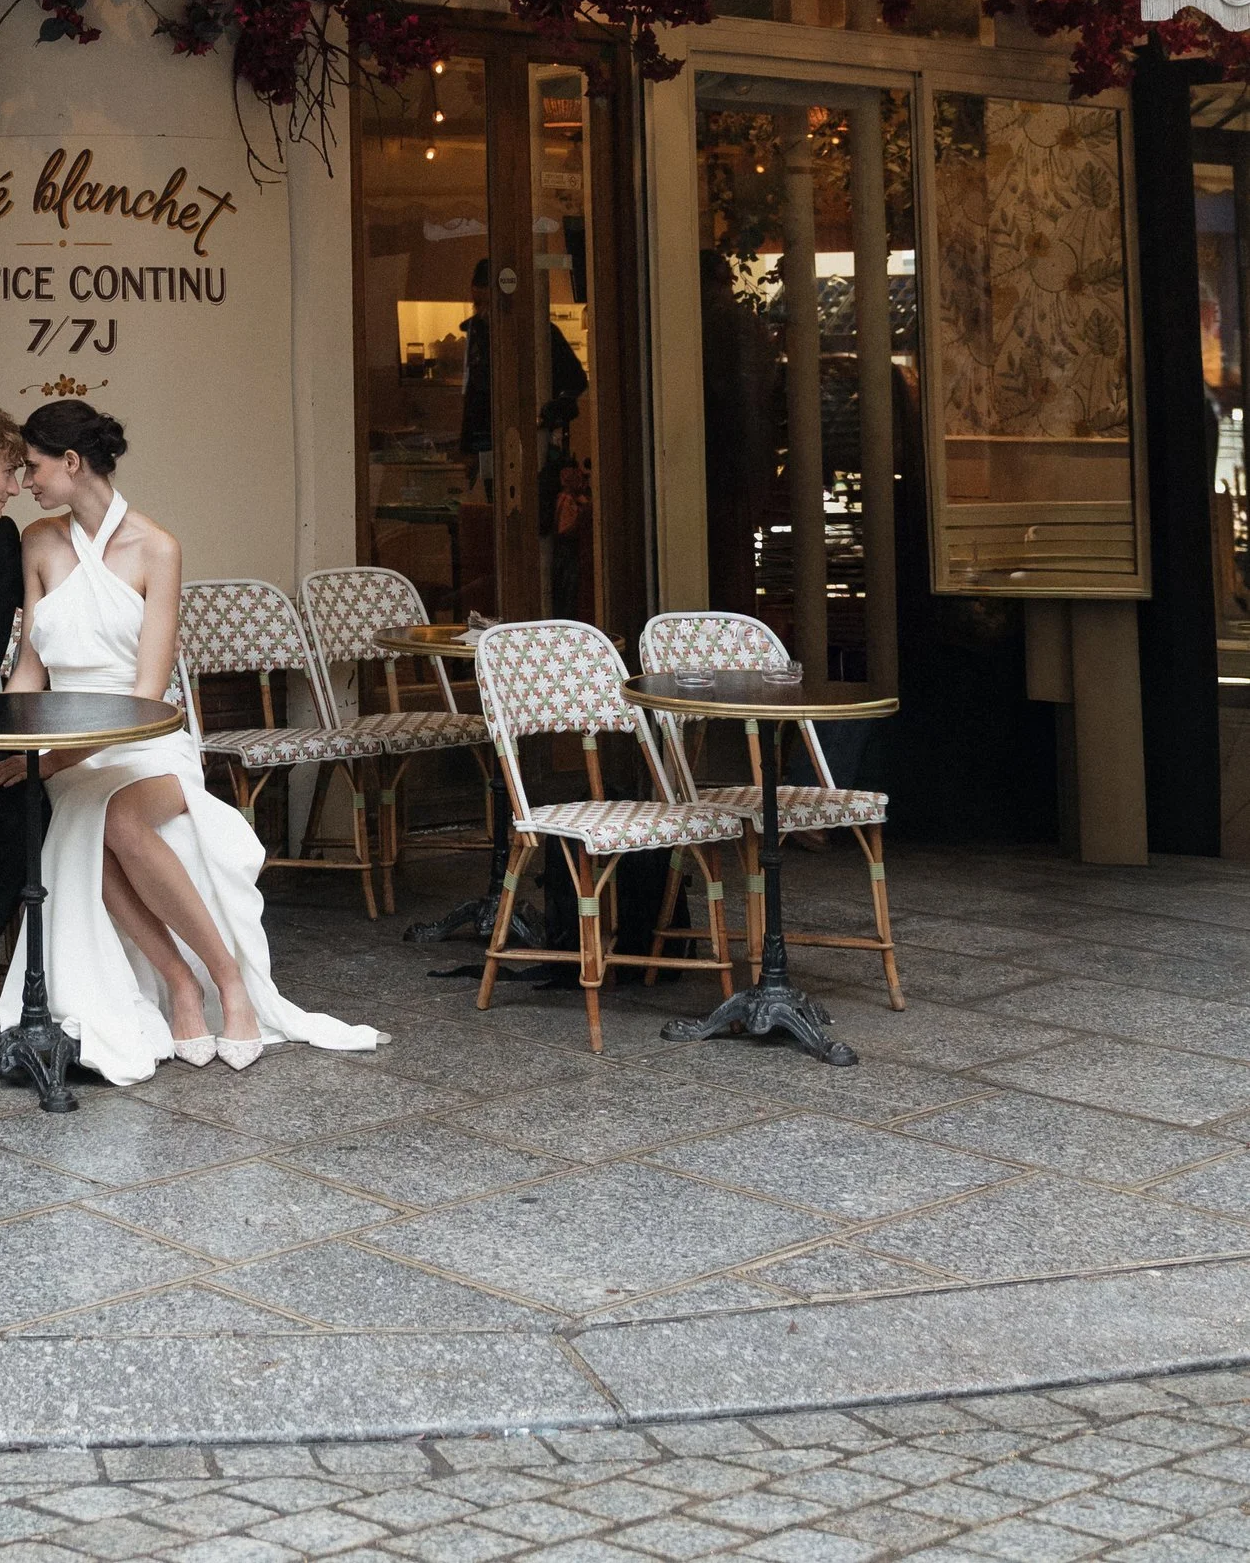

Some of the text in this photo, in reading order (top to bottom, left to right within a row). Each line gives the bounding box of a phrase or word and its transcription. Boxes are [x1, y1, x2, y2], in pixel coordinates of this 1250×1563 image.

[32, 148, 237, 257] blanchet
[69, 265, 227, 305] CONTINU
[26, 315, 119, 357] 7/7J
